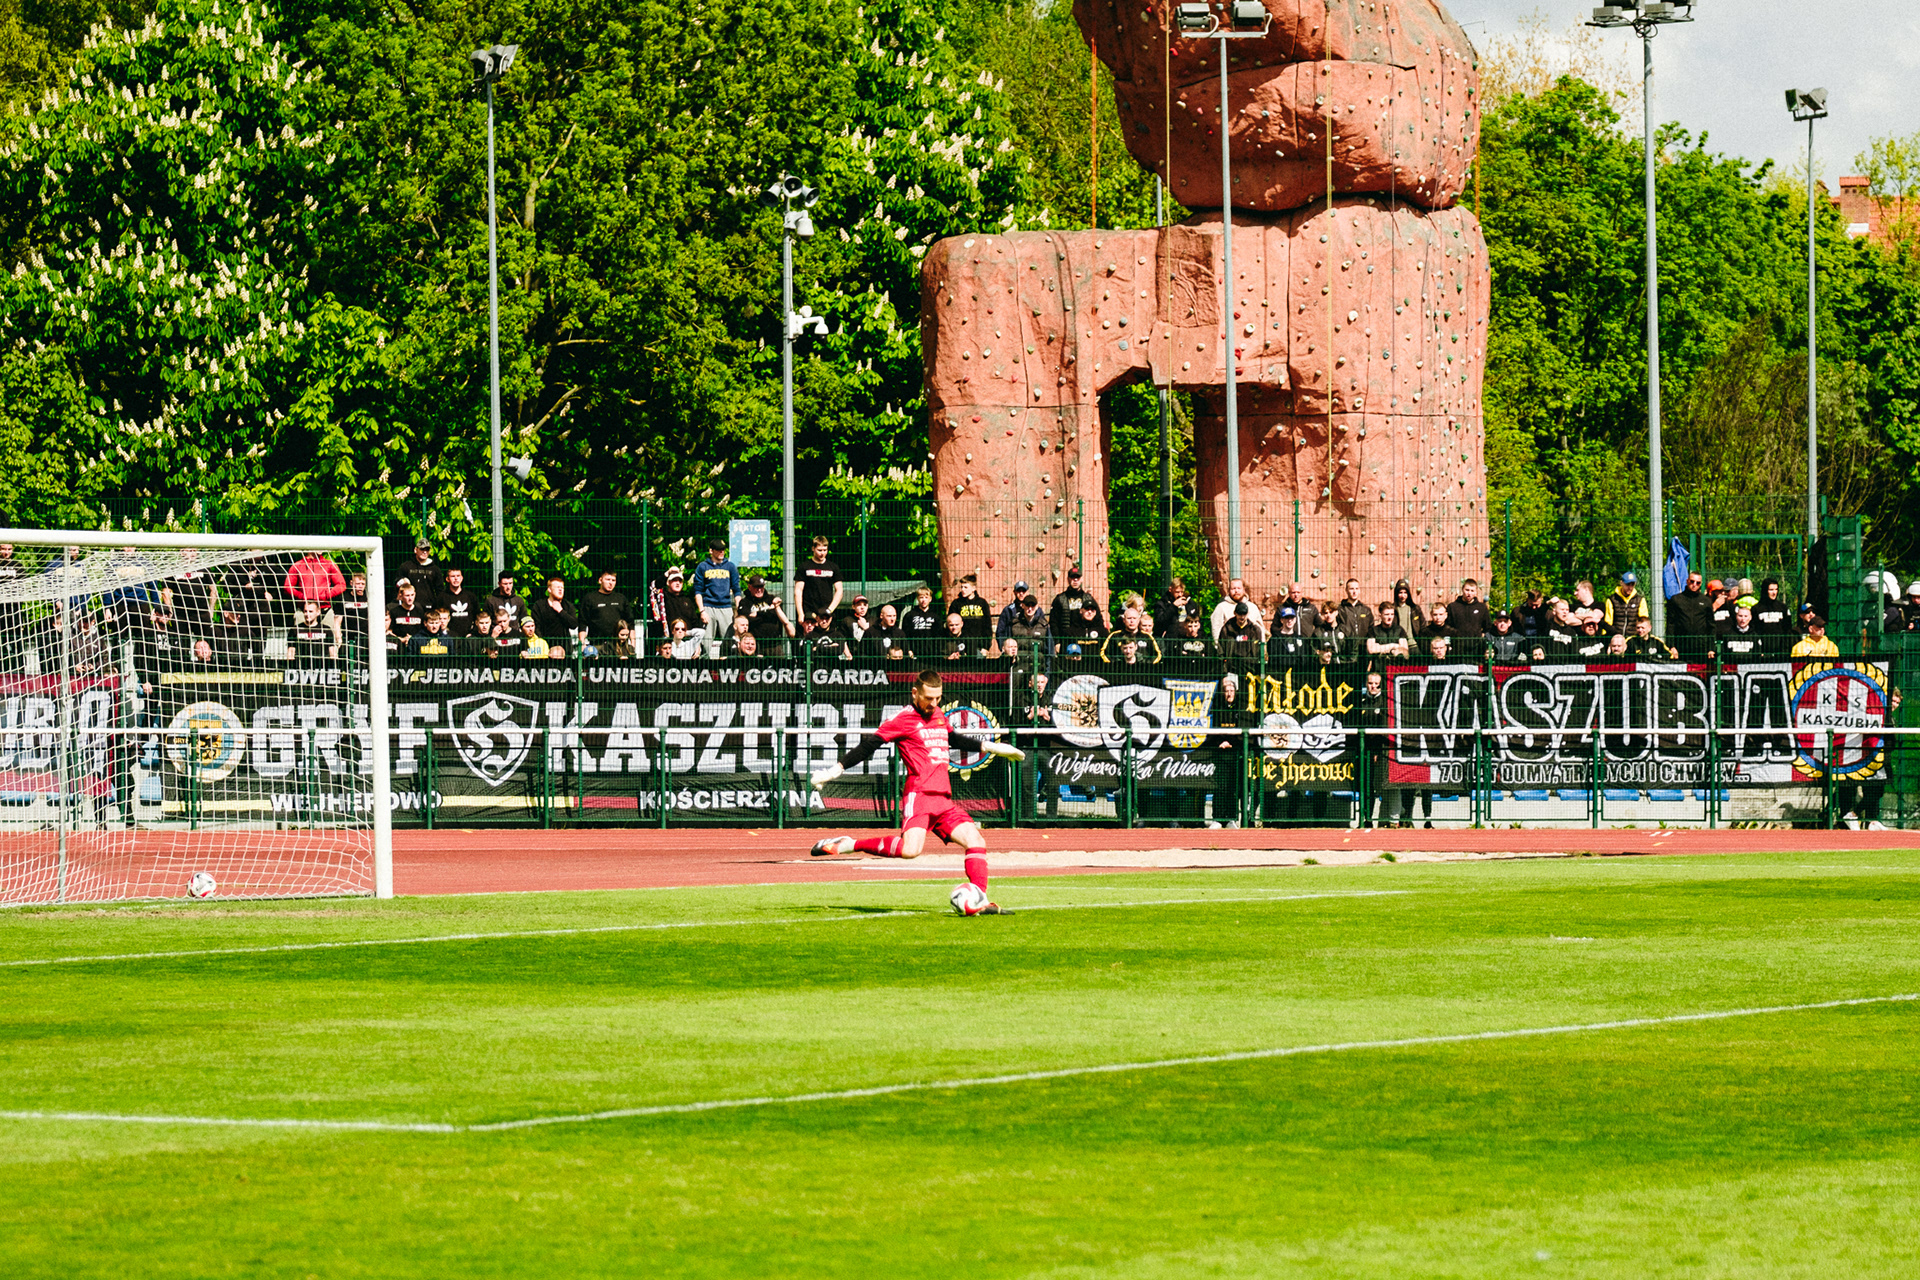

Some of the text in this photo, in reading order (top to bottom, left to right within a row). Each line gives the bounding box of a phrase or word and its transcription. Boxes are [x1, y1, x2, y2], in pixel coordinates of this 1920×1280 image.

[742, 534, 758, 562] F
[285, 665, 889, 688] DWIE EKPY JEDNA BANDA UNIESIONA W GÓRĘ GARDA
[1245, 666, 1354, 716] Młode
[1823, 694, 1861, 708] K S
[1170, 718, 1203, 727] ARKA
[1394, 673, 1797, 763] KASZUBIA
[1803, 713, 1879, 729] KASZUBIA
[253, 703, 439, 776] GRYF
[1048, 751, 1216, 783] Wejheroka Wiara
[1440, 761, 1463, 783] 70
[640, 787, 825, 809] KOŚCIERZYNA
